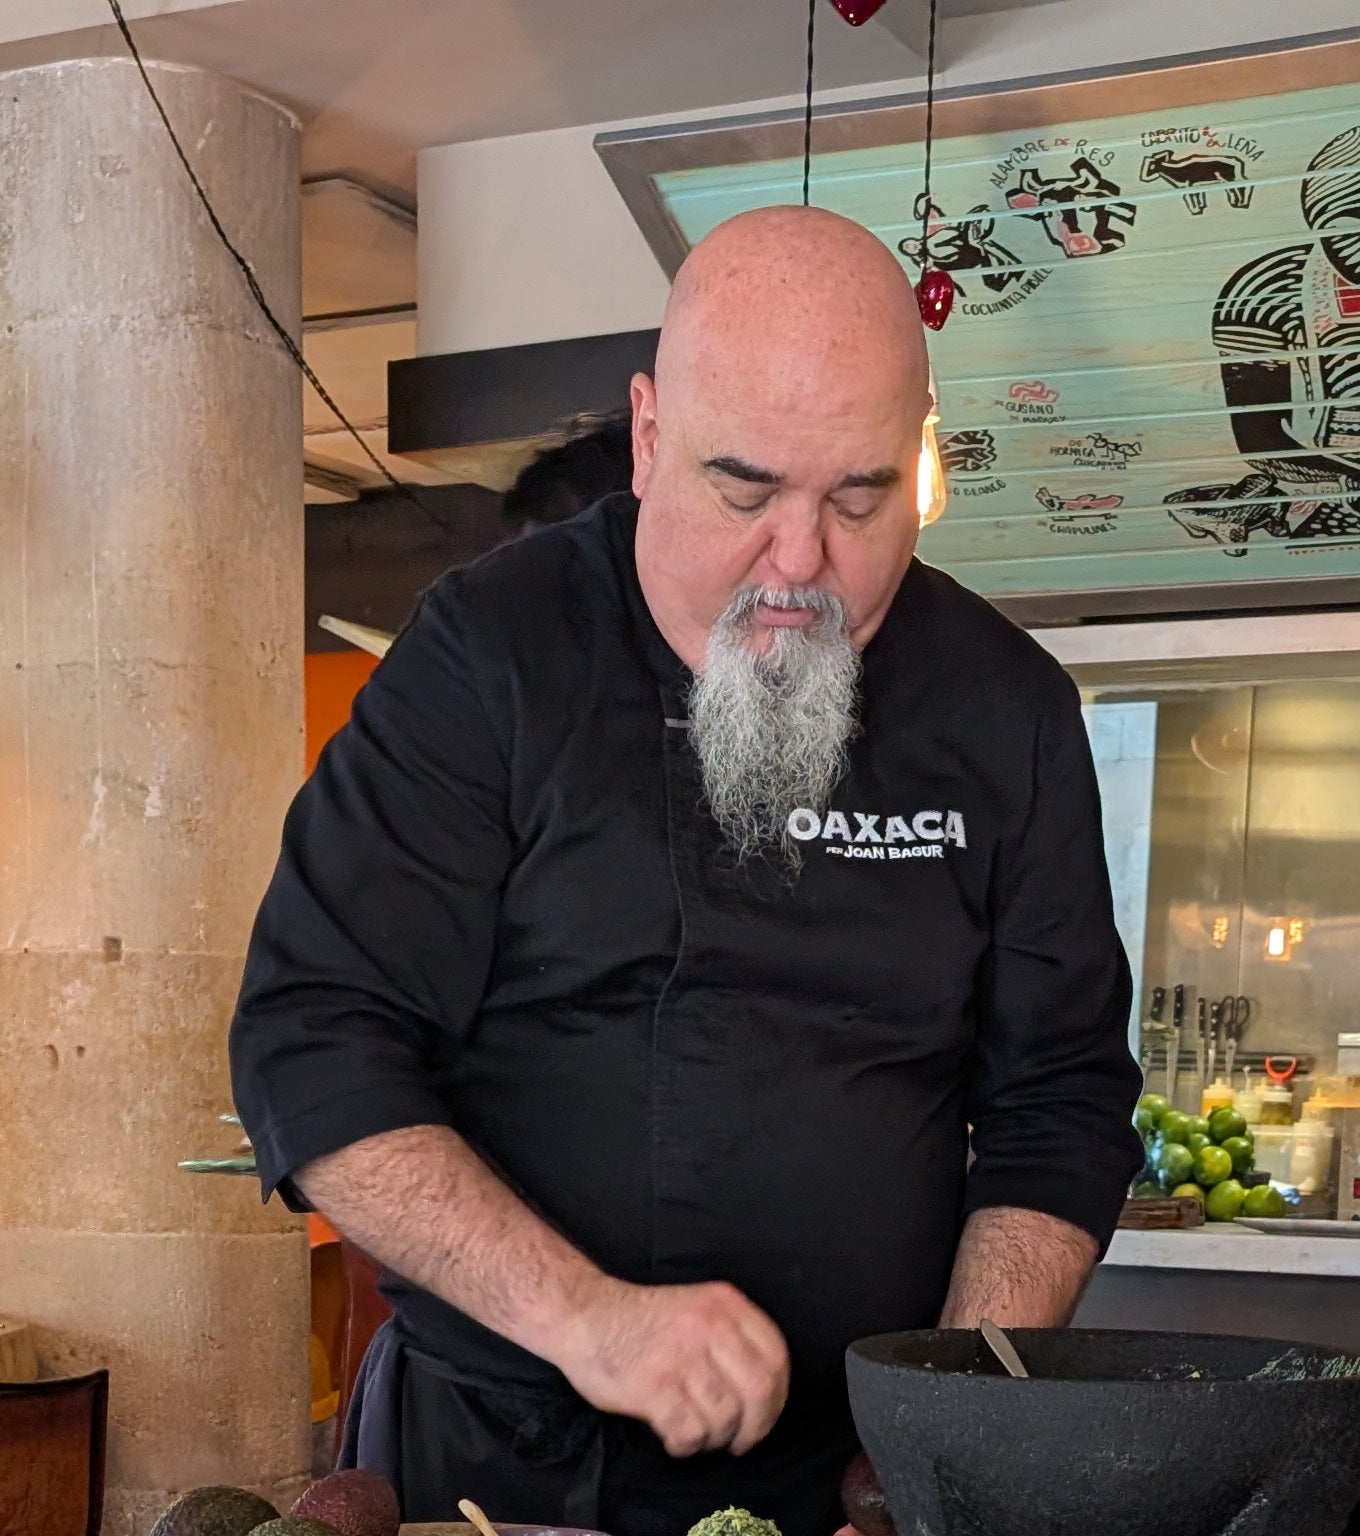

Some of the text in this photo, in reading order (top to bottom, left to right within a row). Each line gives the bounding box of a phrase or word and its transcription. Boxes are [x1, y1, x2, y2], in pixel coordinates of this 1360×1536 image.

[1226, 133, 1265, 162] LEÑA
[989, 139, 1050, 190] ALAMBRE
[1074, 139, 1115, 167] RES
[1005, 401, 1055, 415] GUSANO
[788, 807, 968, 850] OAXACA
[843, 844, 886, 860] JOAN
[888, 844, 945, 860] BAGUR
